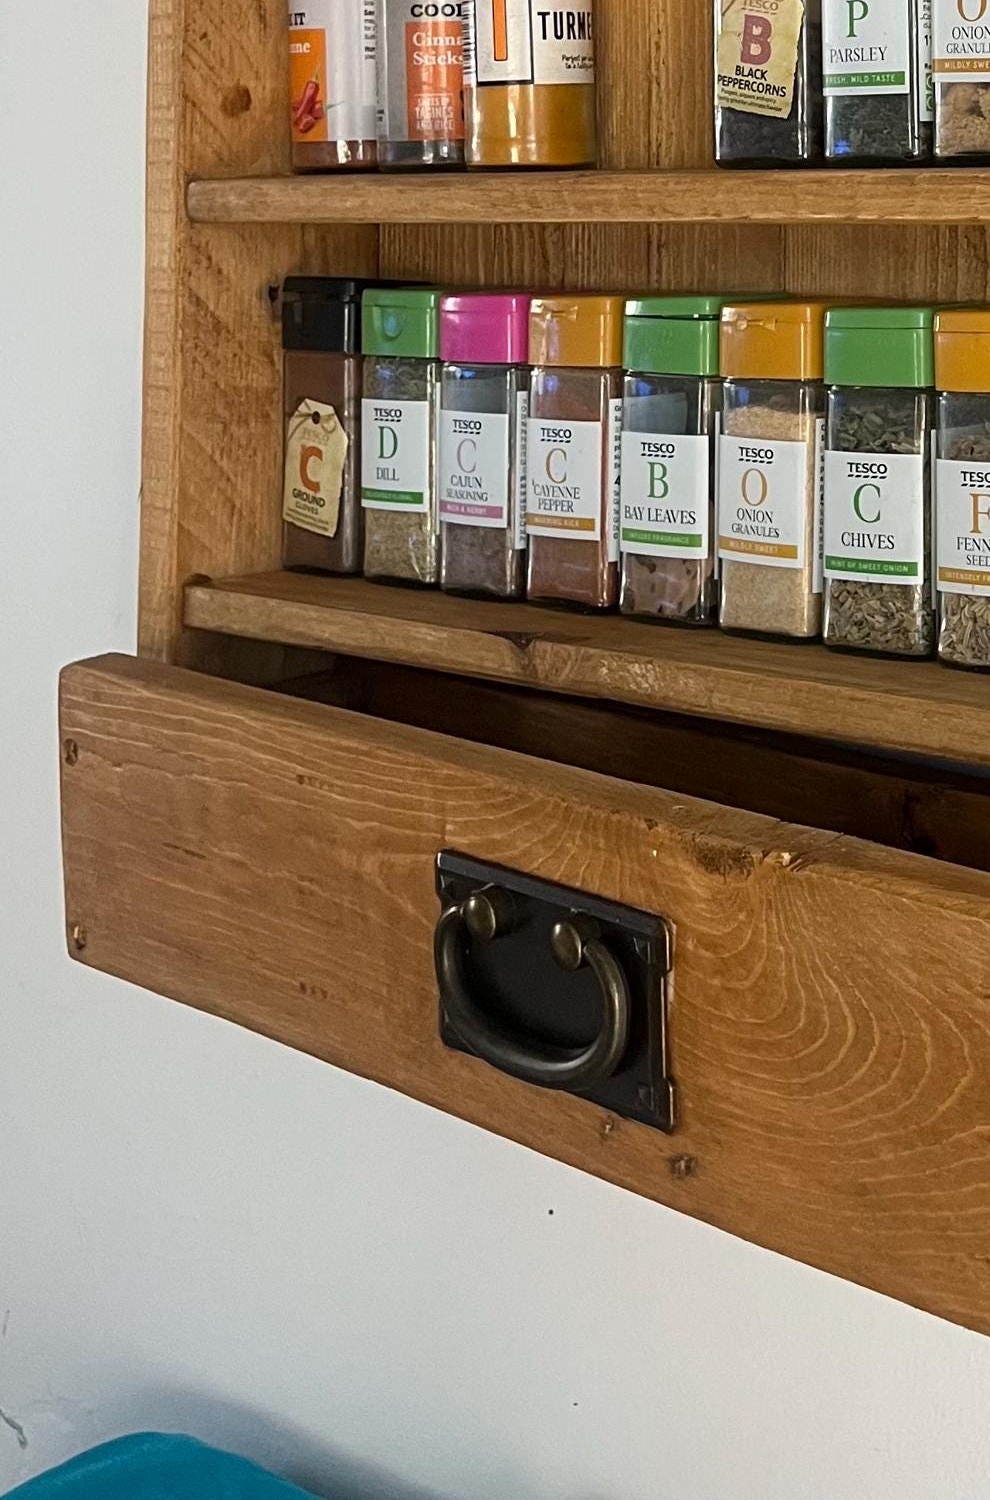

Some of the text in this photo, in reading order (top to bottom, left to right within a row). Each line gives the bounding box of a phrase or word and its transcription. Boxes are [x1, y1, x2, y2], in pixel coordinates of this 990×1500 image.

[537, 11, 592, 41] TURME
[846, 0, 869, 38] P
[413, 31, 464, 47] Cinna
[740, 14, 773, 65] B
[829, 45, 888, 64] PARSLEY
[735, 65, 769, 82] BLACK
[944, 61, 970, 69] MILDLY
[717, 74, 787, 98] PEPPERCORNS
[872, 74, 896, 83] TASTE
[374, 407, 402, 419] TESCO
[453, 418, 482, 430] TESCO
[540, 427, 572, 439] TESCO
[378, 425, 398, 459] D
[641, 441, 675, 454] TESCO
[456, 438, 477, 474] C
[738, 447, 774, 460] TESCO
[299, 445, 323, 494] C
[376, 467, 400, 481] DILL
[545, 447, 567, 484] C
[847, 462, 888, 474] TESCO
[450, 475, 482, 489] CAJUN
[647, 461, 669, 499] B
[741, 468, 768, 507] O
[292, 488, 326, 508] GROUND
[446, 488, 489, 503] SEASONING
[533, 485, 580, 500] CAYENNE
[538, 499, 574, 513] PEPPER
[853, 483, 881, 523] C
[624, 505, 696, 525] BAY LEAVES
[736, 507, 774, 524] ONION
[731, 523, 780, 538] GRANULES
[841, 531, 895, 550] CHIVES
[857, 562, 881, 571] SWEET
[883, 564, 909, 573] ONION
